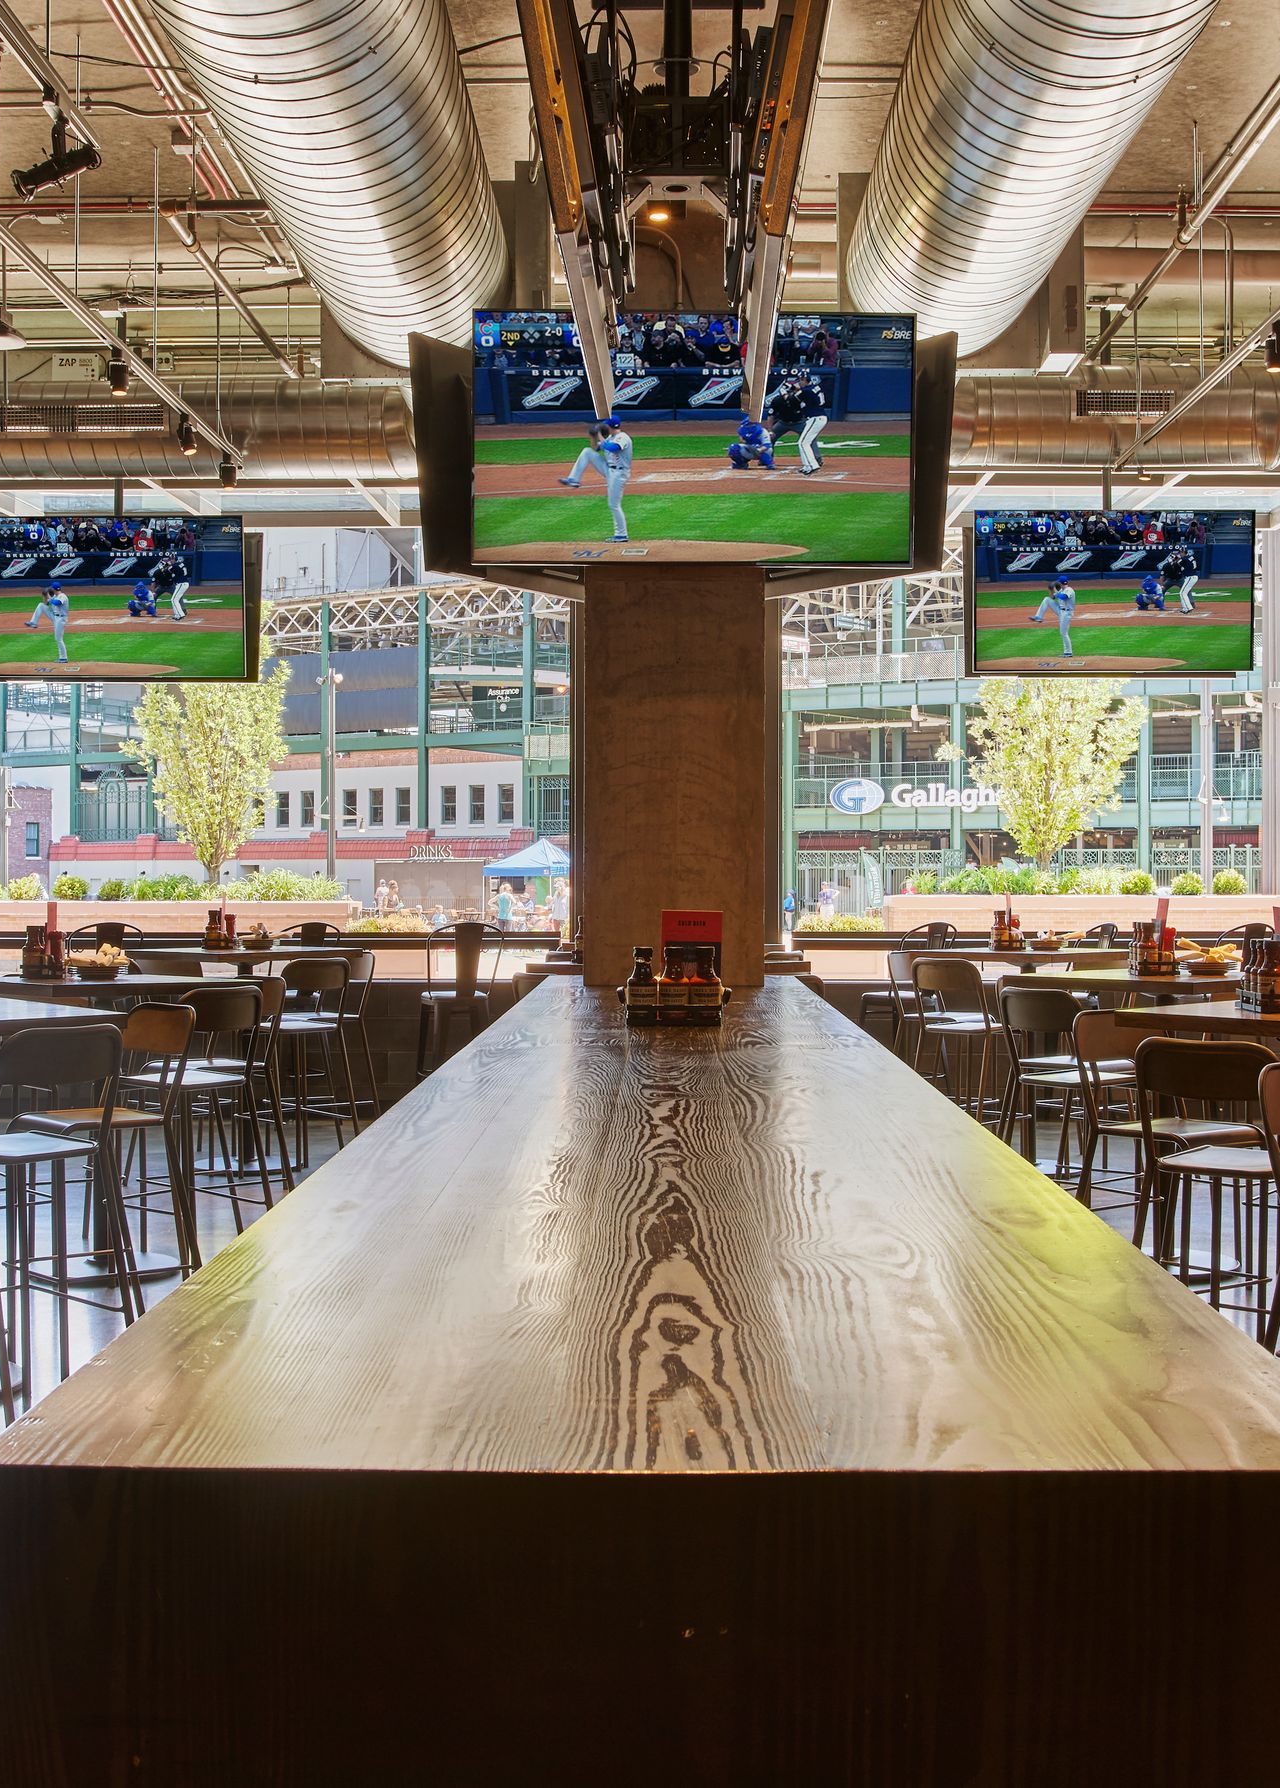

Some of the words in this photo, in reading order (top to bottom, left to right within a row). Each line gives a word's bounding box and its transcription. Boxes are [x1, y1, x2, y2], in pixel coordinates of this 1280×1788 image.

[501, 331, 521, 341] 2ND
[545, 327, 563, 337] 2-0
[481, 336, 494, 347] 0
[59, 358, 77, 367] ZAP
[702, 368, 810, 376] BREW.CO
[487, 687, 520, 698] Assurance
[496, 695, 511, 703] Club
[891, 783, 1016, 813] Gallagh
[410, 844, 452, 858] DRINKS
